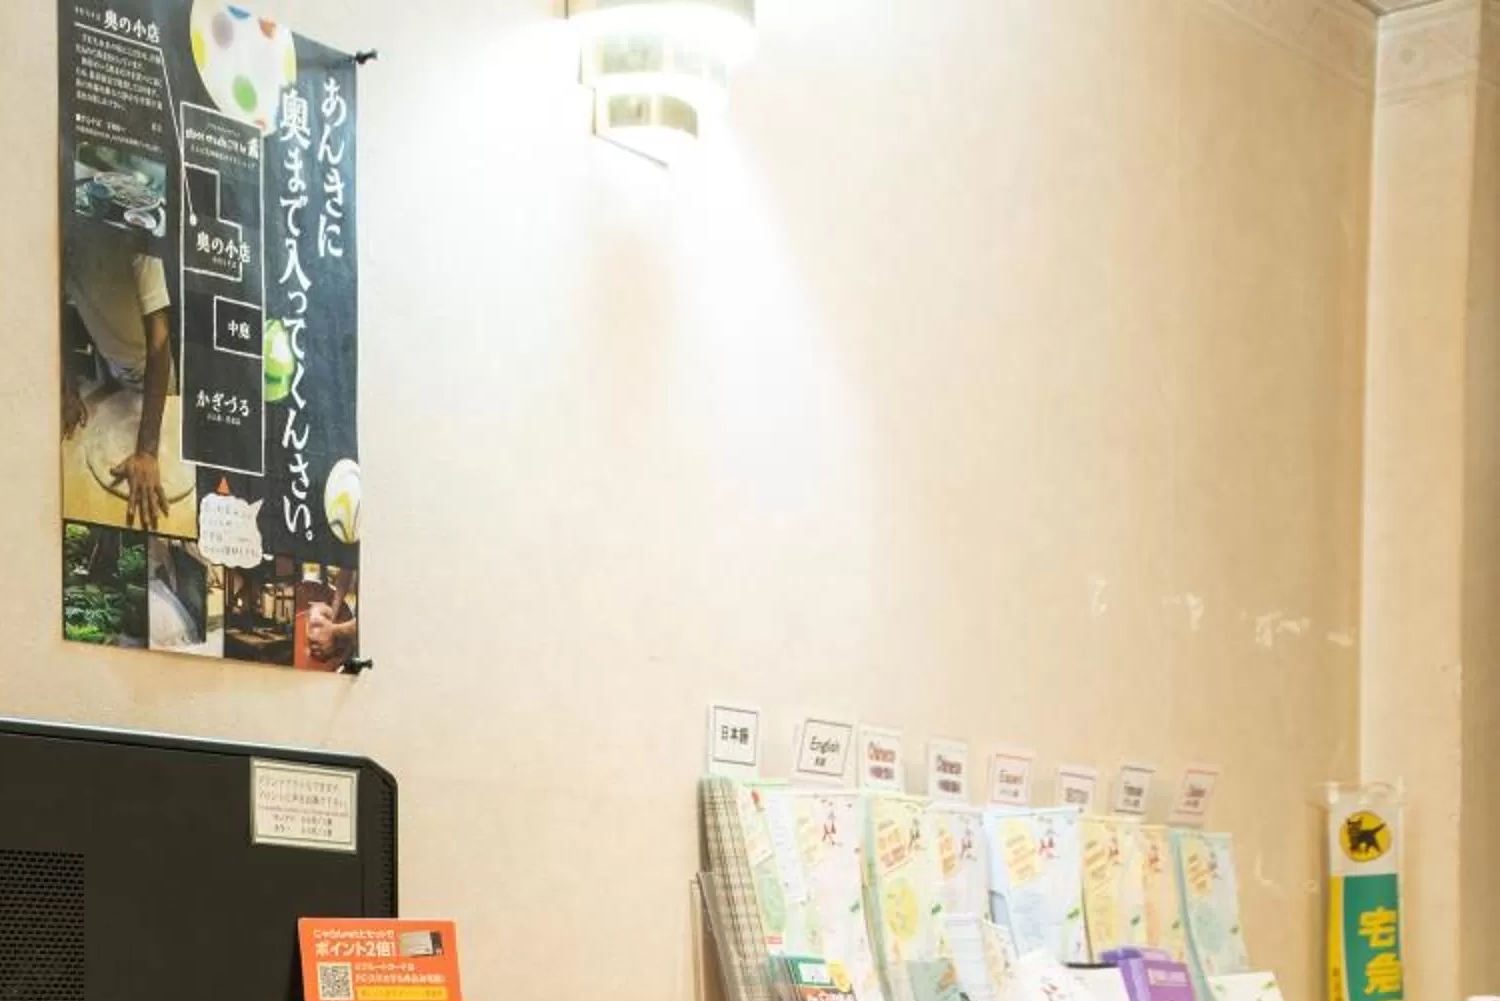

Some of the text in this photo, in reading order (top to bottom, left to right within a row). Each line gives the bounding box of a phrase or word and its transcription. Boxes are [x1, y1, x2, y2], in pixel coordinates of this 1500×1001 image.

[103, 9, 161, 44] 奥の小店
[317, 75, 348, 258] あんきに
[196, 231, 251, 264] 奥の小店
[279, 88, 314, 541] 奥まで入ってくんさい。
